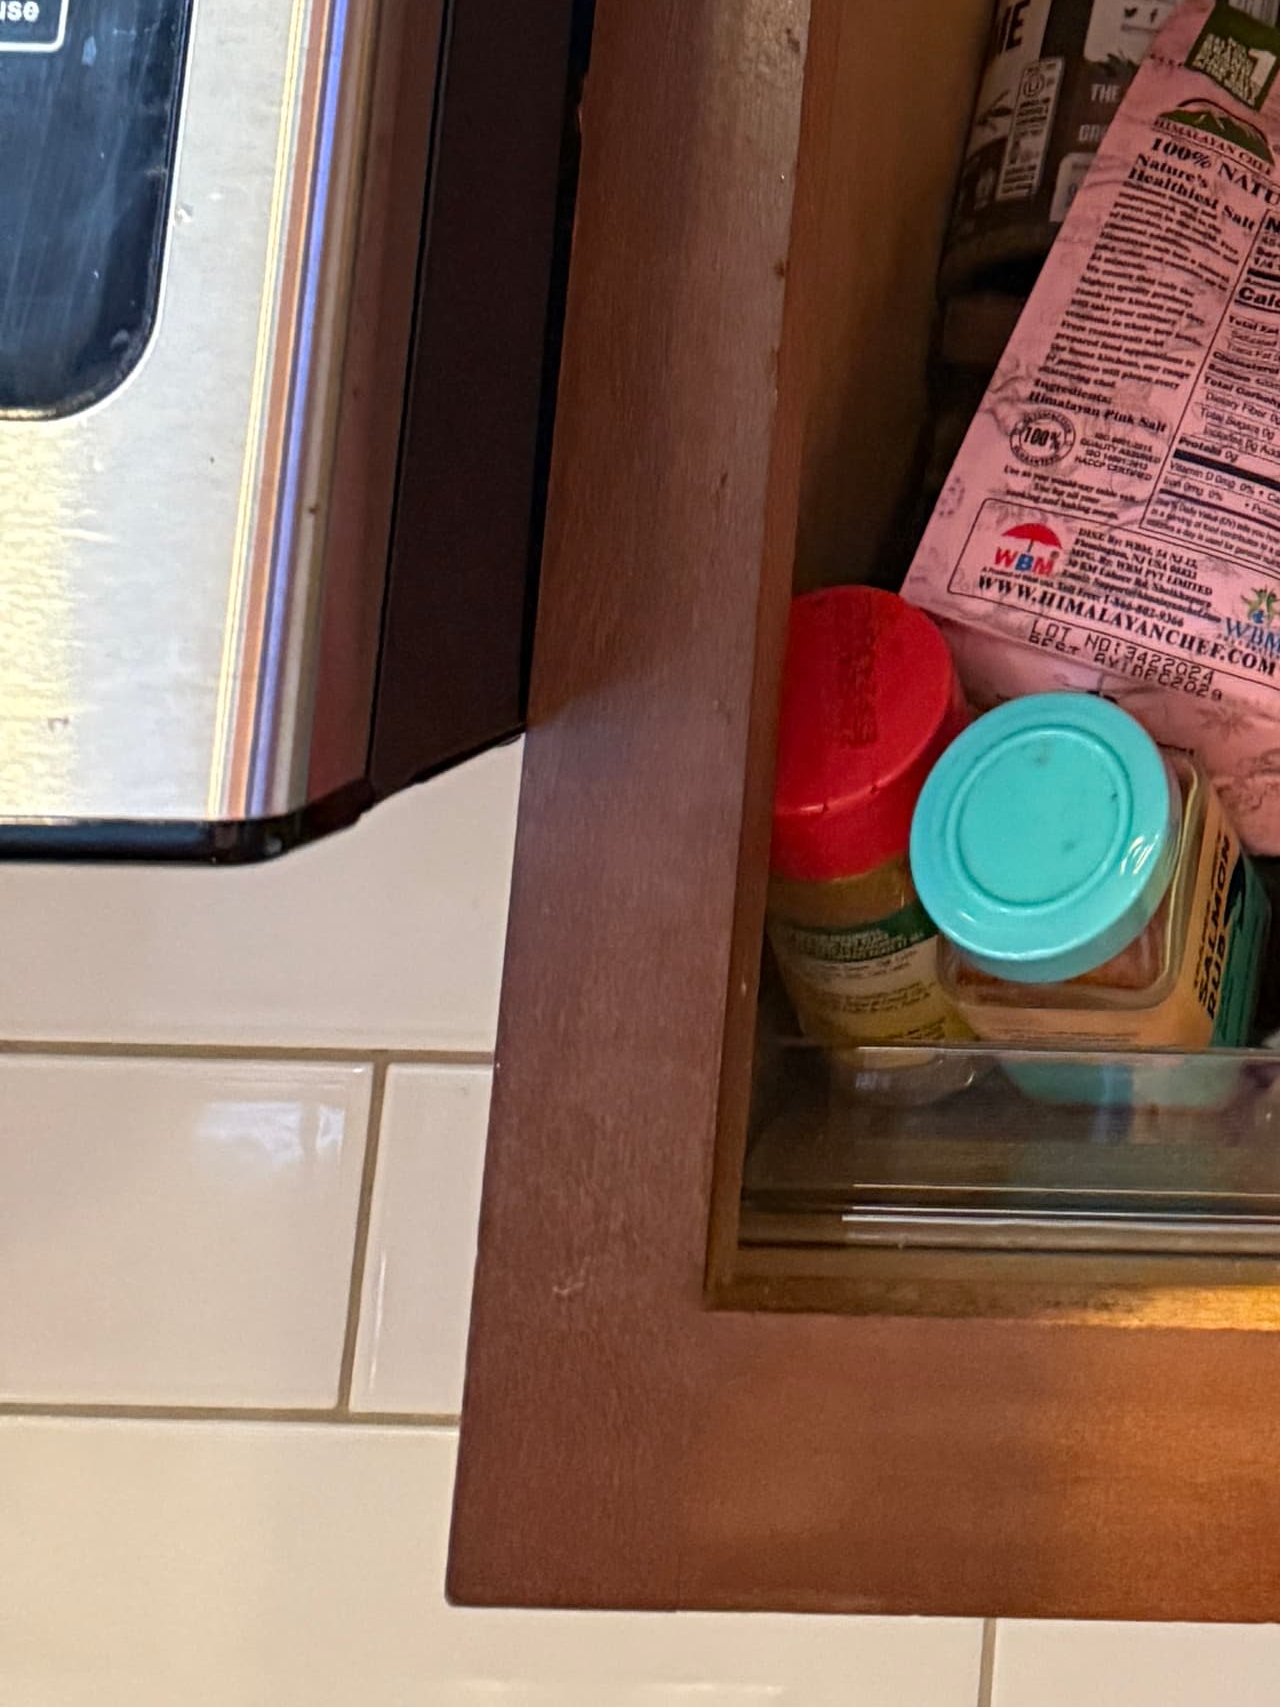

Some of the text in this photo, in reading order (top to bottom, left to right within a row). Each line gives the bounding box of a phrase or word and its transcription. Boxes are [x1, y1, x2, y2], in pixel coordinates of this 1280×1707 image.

[1152, 138, 1211, 168] 100%
[1127, 168, 1255, 230] Healthiest Salt
[993, 547, 1054, 575] WBM
[978, 576, 1277, 677] WWW.HIMALAYANCHEF.COM
